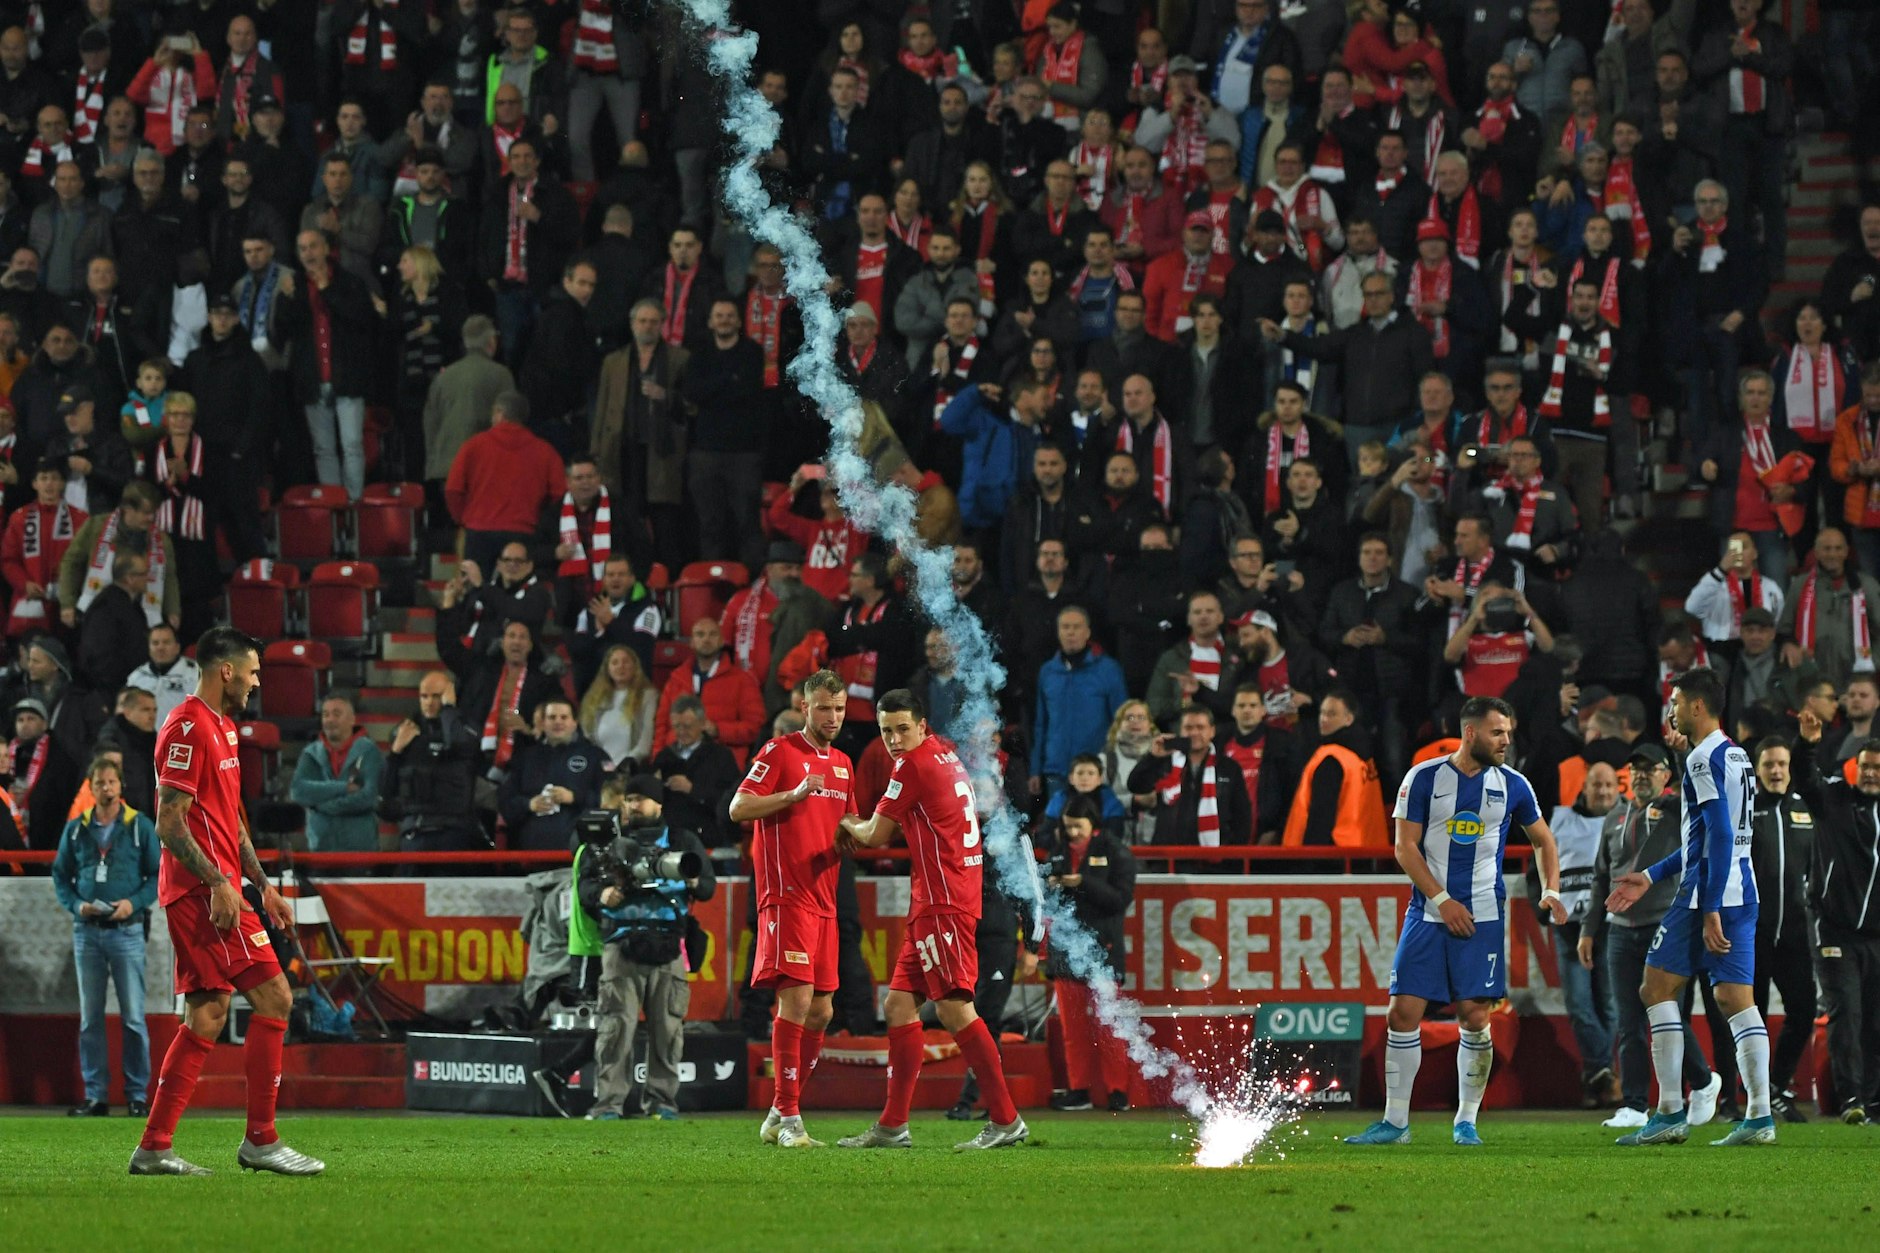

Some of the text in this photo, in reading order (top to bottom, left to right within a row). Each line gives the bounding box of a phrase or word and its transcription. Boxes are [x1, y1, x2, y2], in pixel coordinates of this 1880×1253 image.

[1446, 820, 1485, 836] TEDi
[916, 933, 940, 973] 31
[1487, 953, 1498, 978] 7
[1269, 1007, 1350, 1034] ONE
[430, 1061, 526, 1085] BUNDESLIGA
